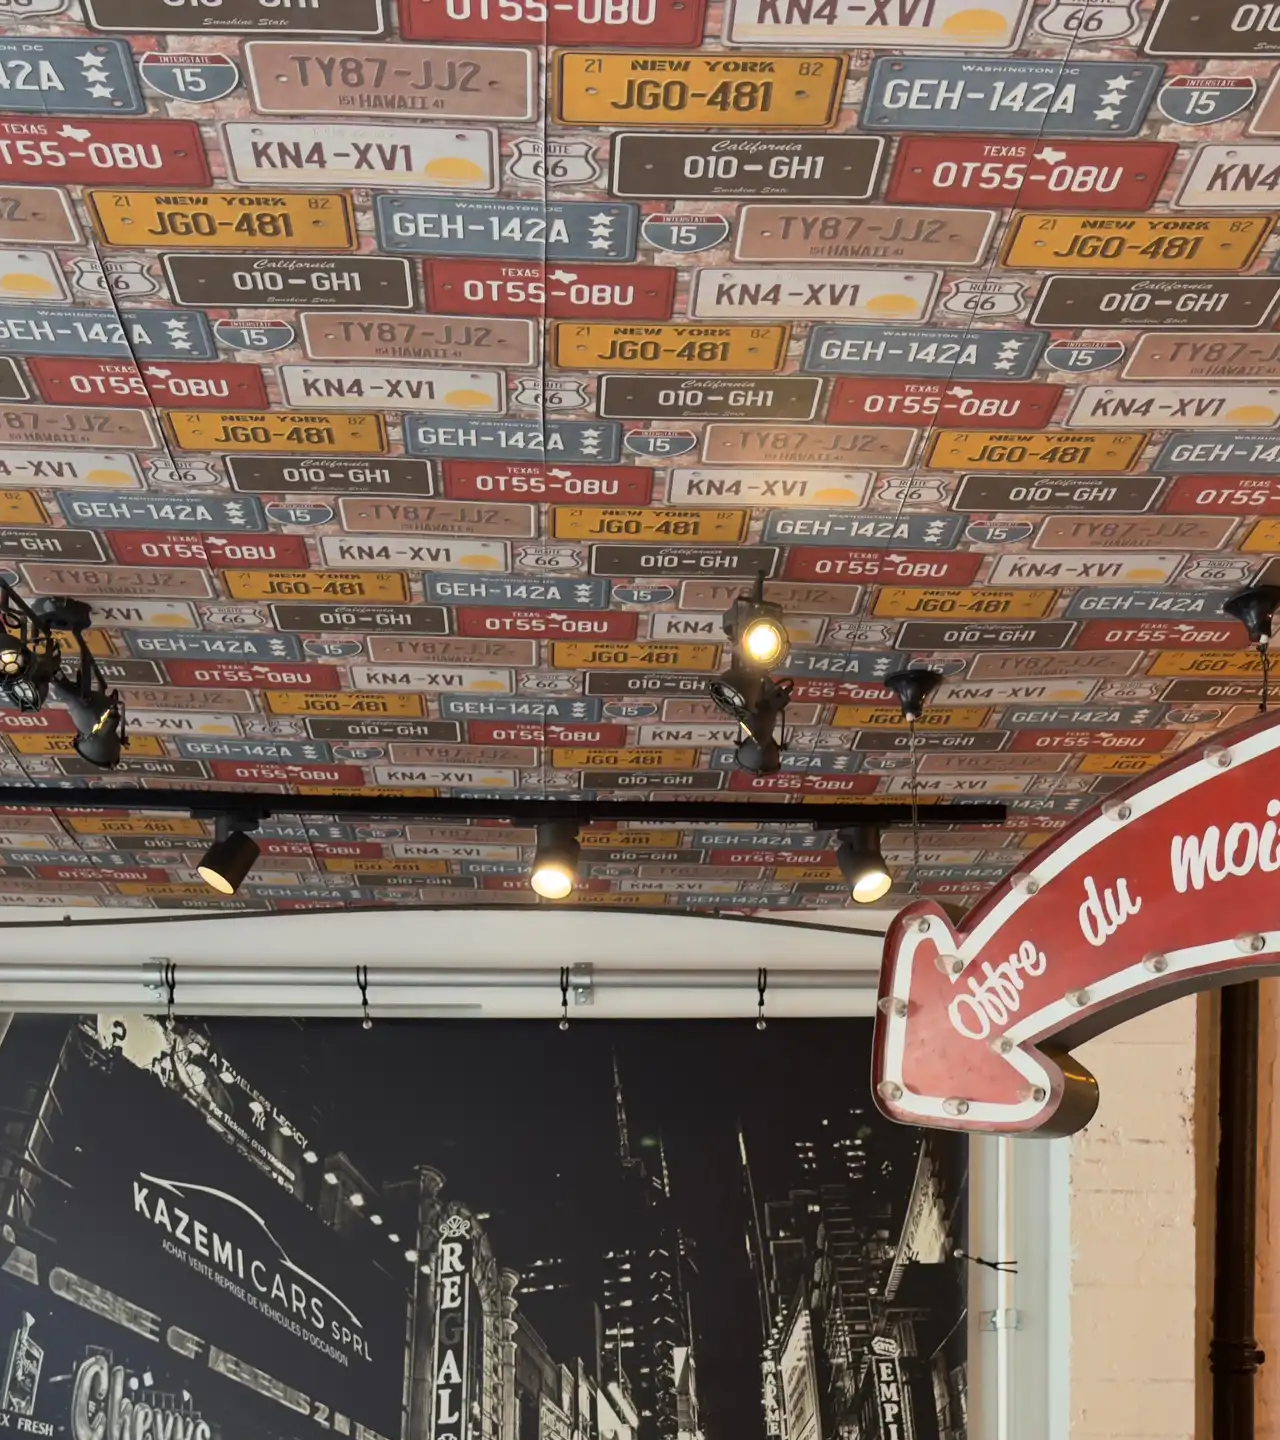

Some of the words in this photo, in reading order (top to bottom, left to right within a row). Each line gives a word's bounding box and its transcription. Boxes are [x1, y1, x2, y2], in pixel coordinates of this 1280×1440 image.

[1062, 5, 1106, 34] 66
[631, 61, 691, 72] NEW
[705, 62, 775, 73] YORK
[172, 67, 206, 91] 15
[883, 76, 1075, 116] GEH-142A
[1186, 91, 1220, 114] 15
[1, 122, 47, 134] TEXAS
[711, 136, 802, 154] California
[984, 146, 1026, 157] TEXAS
[533, 158, 569, 178] 66
[393, 212, 568, 245] GEH-142A
[671, 226, 697, 245] 15
[94, 274, 132, 291] 66
[962, 294, 1000, 311] 66
[436, 583, 561, 600] GEH-142A
[947, 940, 1048, 1040] Offre
[1078, 876, 1142, 947] du
[133, 1181, 245, 1279] KAZEMI
[251, 1260, 325, 1329] CARS
[332, 1321, 373, 1362] SPRL
[188, 1254, 214, 1280] VENTE
[436, 1242, 466, 1426] REGAL
[16, 1418, 54, 1437] FRESH
